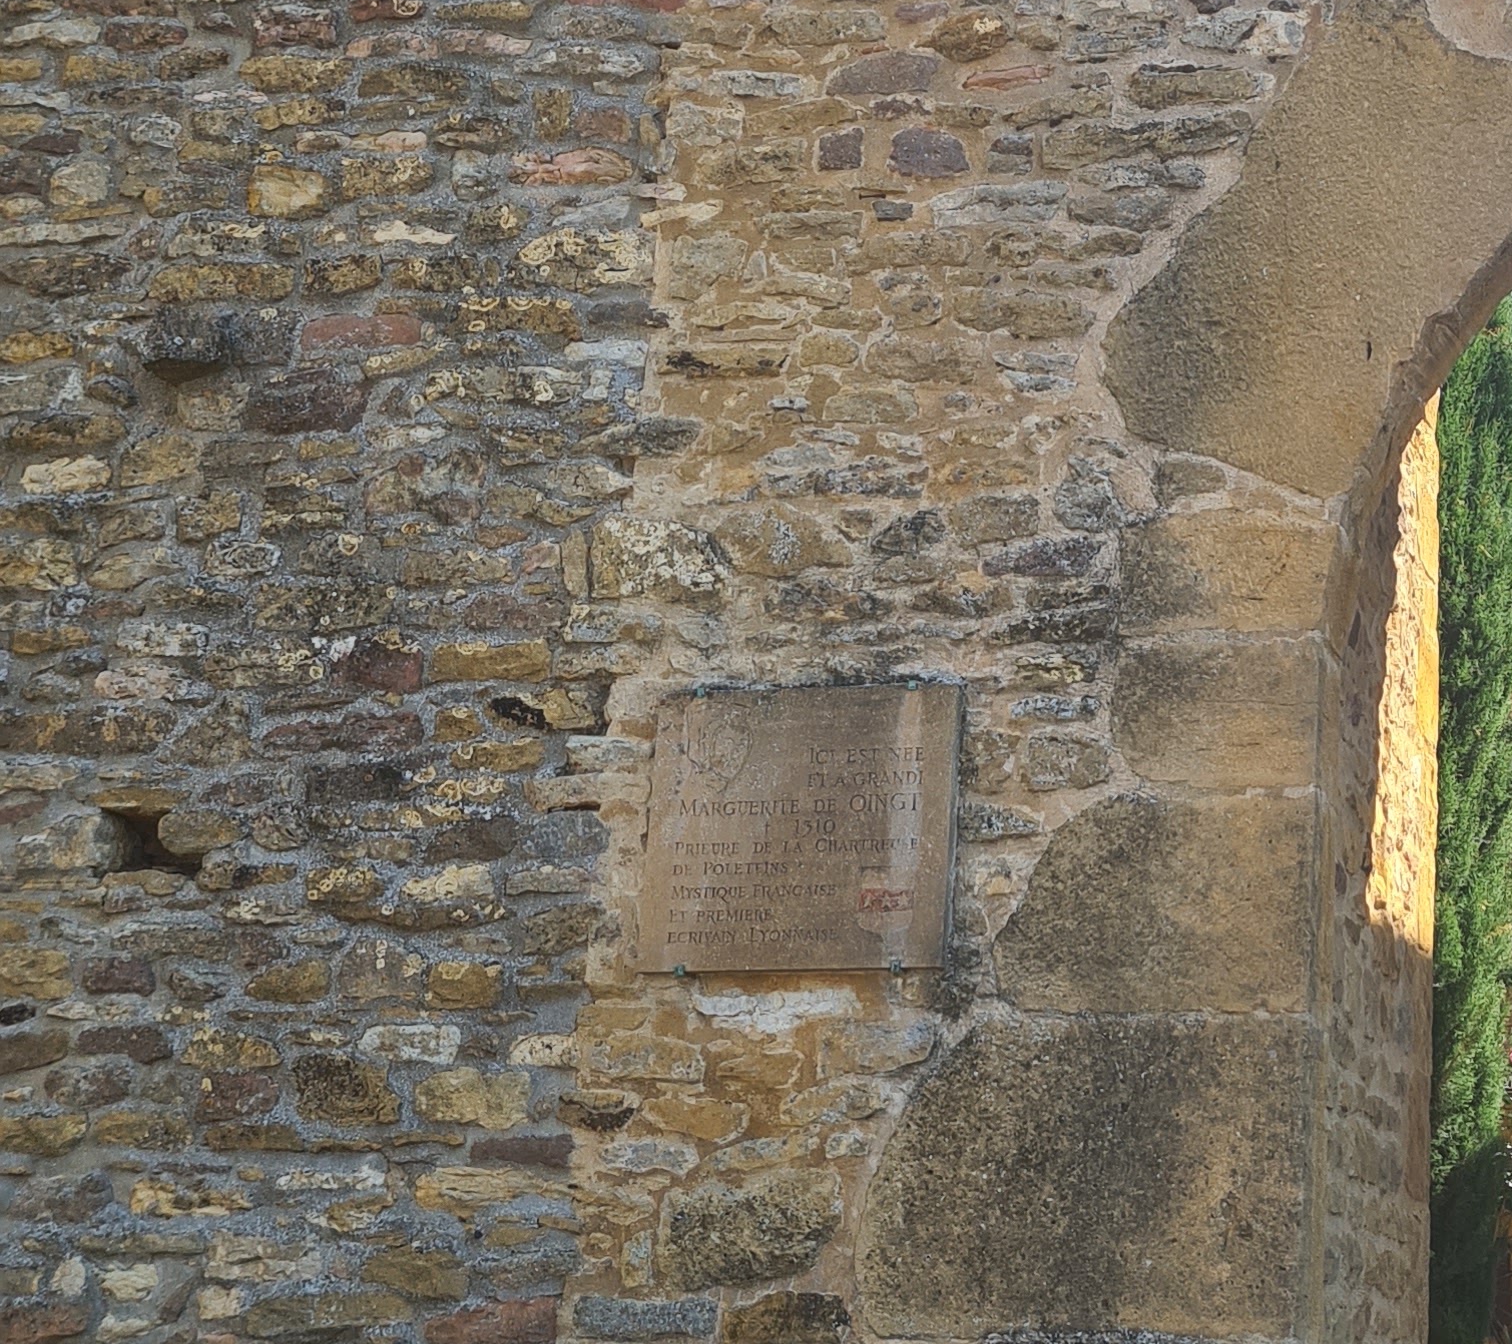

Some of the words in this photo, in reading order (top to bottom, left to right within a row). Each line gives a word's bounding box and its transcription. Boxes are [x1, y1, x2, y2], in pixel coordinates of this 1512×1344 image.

[810, 747, 835, 764] ICI
[847, 748, 880, 764] EST
[853, 771, 924, 787] GRANDI
[680, 798, 800, 819] MARGUERITE
[814, 798, 837, 813] DE
[849, 793, 922, 812] OINGT
[753, 840, 772, 854] DE
[784, 840, 802, 854] LA
[671, 885, 747, 903] MYSTIQUE
[669, 909, 688, 924] ET
[749, 927, 839, 944] LYONNAISE
